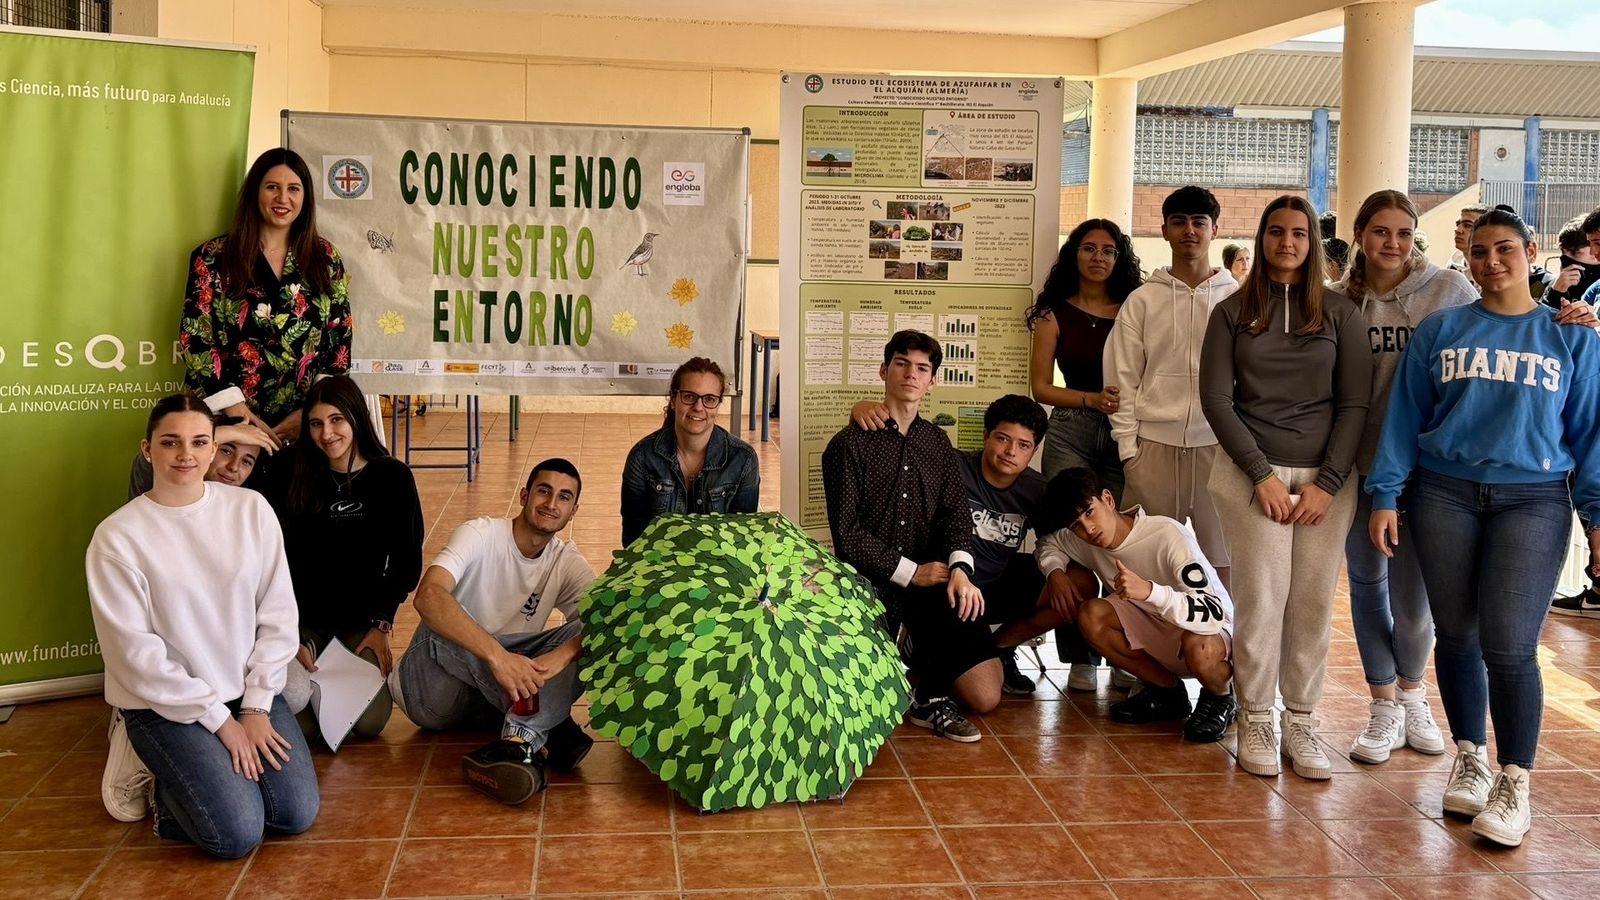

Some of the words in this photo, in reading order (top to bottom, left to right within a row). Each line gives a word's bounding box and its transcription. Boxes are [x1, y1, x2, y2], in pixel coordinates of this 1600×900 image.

[10, 79, 64, 98] Ciencia,
[68, 81, 100, 98] más
[104, 83, 150, 102] futuro
[152, 92, 176, 104] para
[179, 92, 231, 107] Andalucía
[886, 86, 923, 94] ALQUIÁN
[926, 87, 968, 96] (ALMERÍA)
[400, 150, 642, 210] CONOCIENDO
[665, 184, 700, 192] engloba
[432, 222, 595, 280] NUESTRO
[433, 290, 593, 347] ENTORNO
[0, 334, 185, 372] ESQBR
[1440, 347, 1562, 393] GIANTS
[0, 382, 30, 396] CIÓN
[34, 382, 106, 396] ANDALUZA
[108, 381, 142, 394] PARA
[146, 381, 162, 393] LA
[0, 402, 18, 414] LA
[21, 398, 100, 412] INNOVACIÓN
[102, 399, 110, 410] Y
[113, 398, 128, 410] EL
[132, 398, 160, 410] CON
[970, 508, 1020, 537] didas
